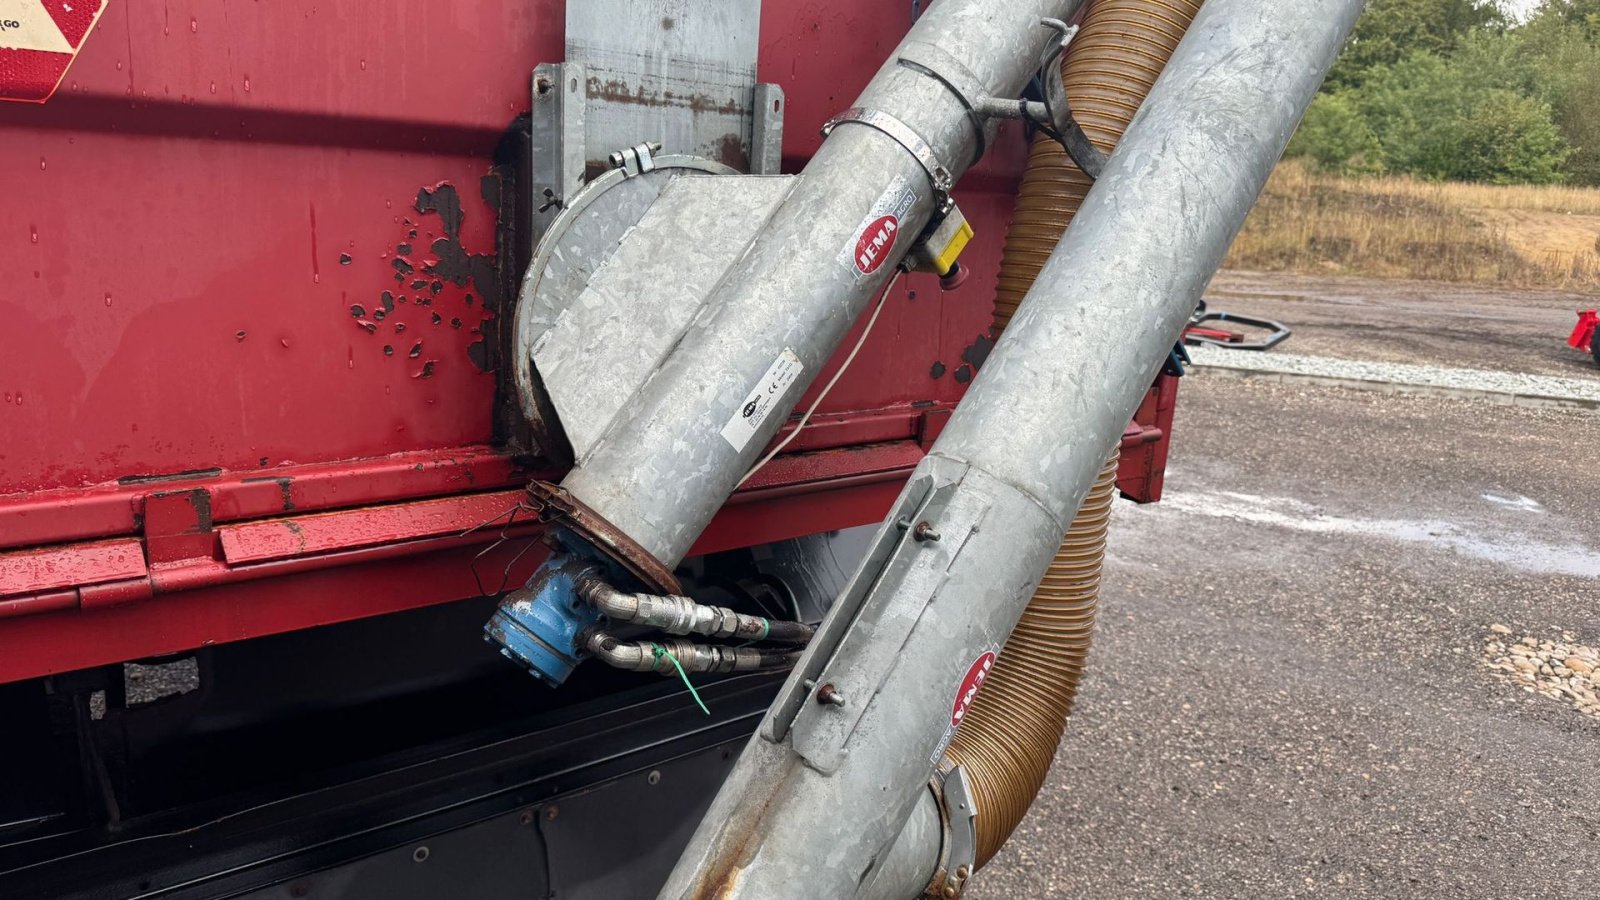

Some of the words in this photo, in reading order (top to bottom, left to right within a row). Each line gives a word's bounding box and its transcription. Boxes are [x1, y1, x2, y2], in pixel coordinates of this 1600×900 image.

[860, 220, 896, 270] JEMA
[897, 194, 913, 218] AGRO
[954, 654, 991, 719] JEMA
[934, 728, 952, 759] AGRO
